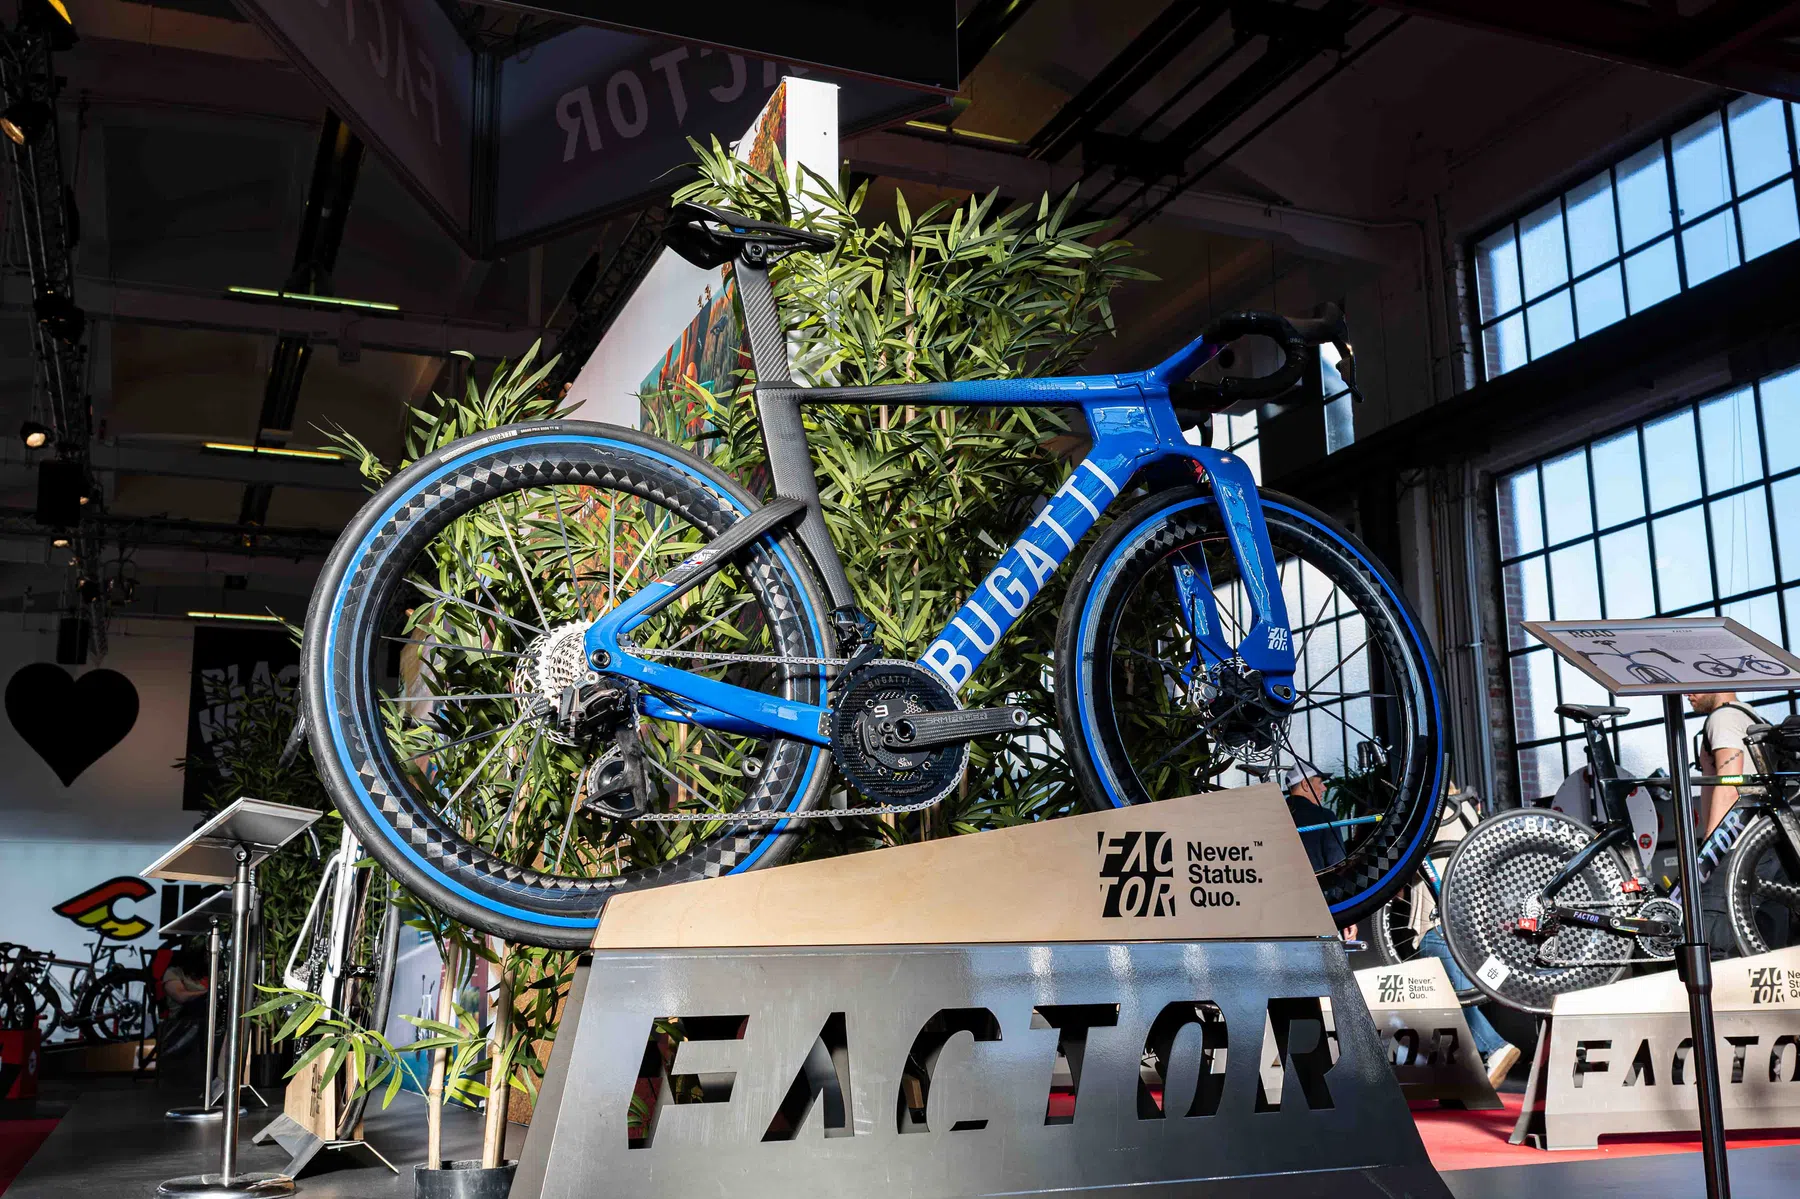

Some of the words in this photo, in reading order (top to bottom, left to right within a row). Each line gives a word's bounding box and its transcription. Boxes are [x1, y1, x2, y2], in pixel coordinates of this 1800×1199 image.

[922, 458, 1120, 694] BUGATTI
[867, 675, 911, 689] BUGATTI
[898, 758, 913, 768] SRM
[1097, 831, 1174, 873] FAC
[1188, 864, 1262, 884] Status.
[1099, 875, 1176, 917] TOR
[1190, 886, 1241, 909] Quo.
[1573, 911, 1600, 923] FACTOR
[1409, 991, 1428, 1000] Quo.
[626, 997, 1342, 1150] FACTOR
